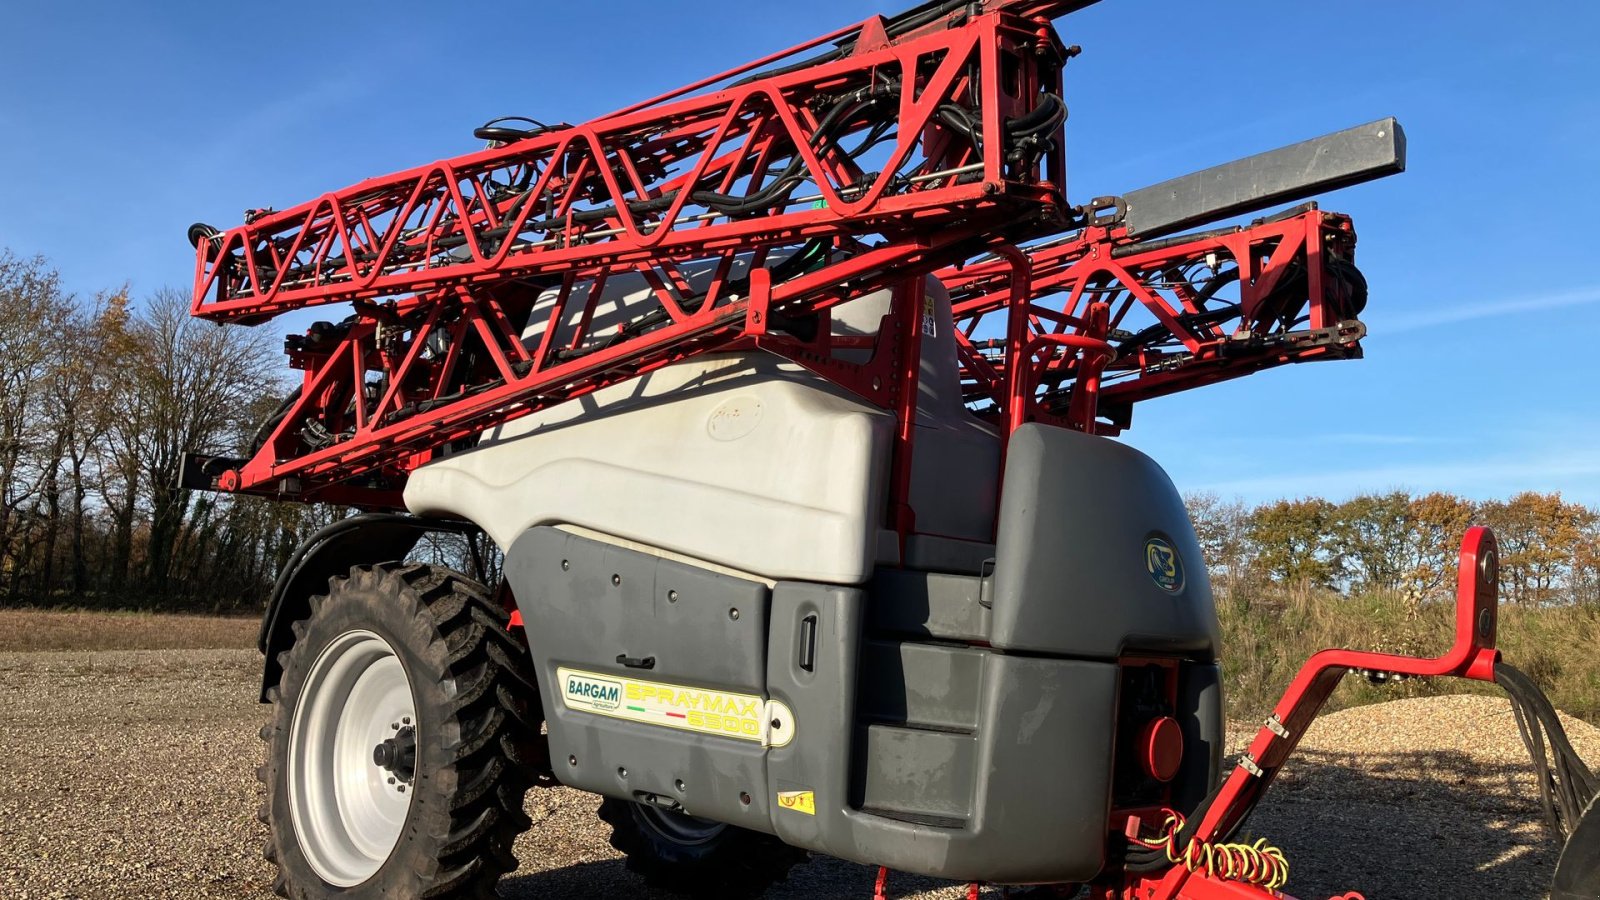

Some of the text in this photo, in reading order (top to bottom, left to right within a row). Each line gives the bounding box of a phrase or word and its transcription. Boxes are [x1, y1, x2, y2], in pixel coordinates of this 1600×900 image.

[569, 680, 618, 702] BARGAM
[625, 683, 758, 717] SPRAYMAX
[687, 710, 760, 735] 6500
